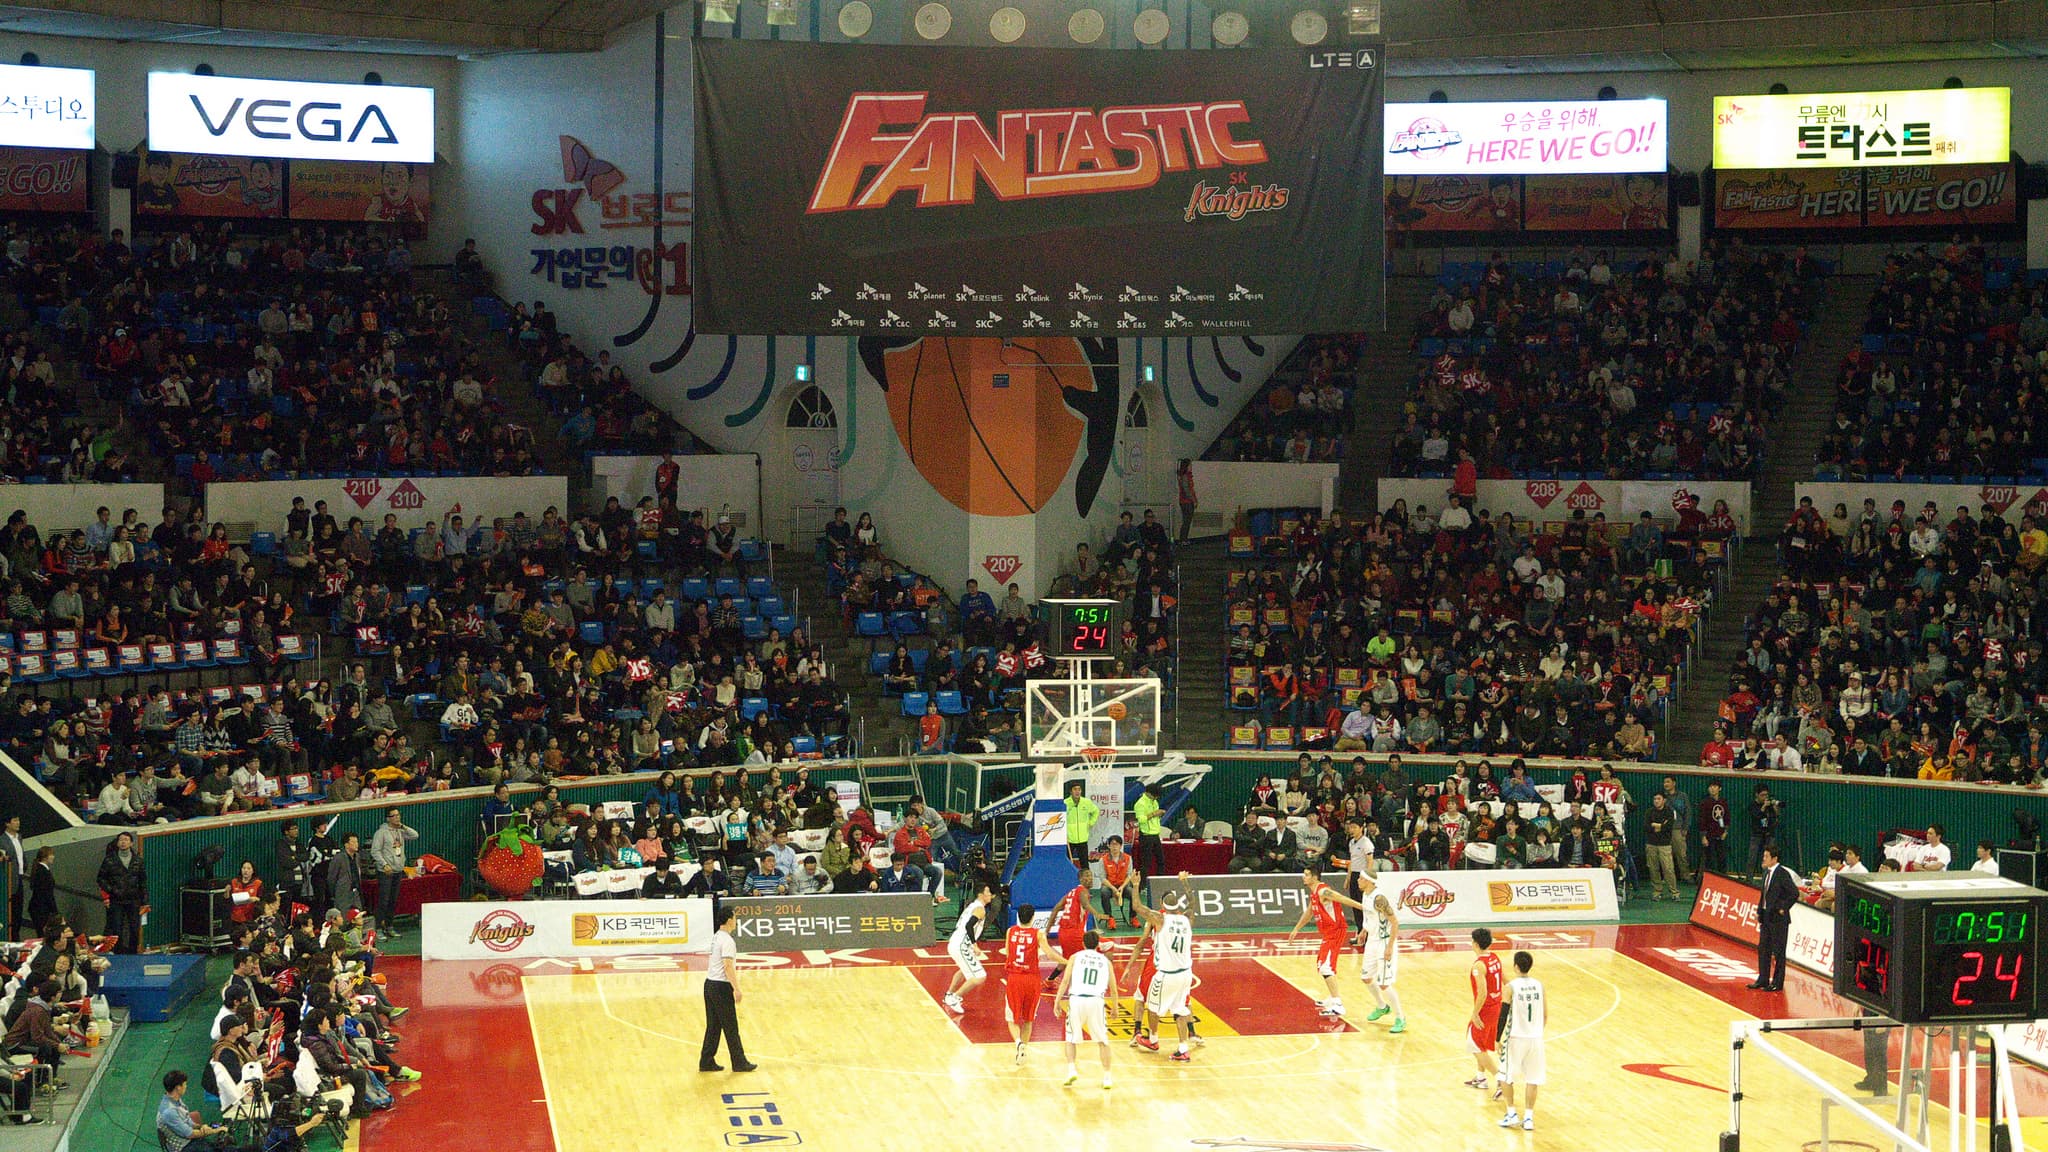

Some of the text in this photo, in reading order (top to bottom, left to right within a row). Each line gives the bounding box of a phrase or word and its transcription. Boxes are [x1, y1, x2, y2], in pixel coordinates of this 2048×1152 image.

[1309, 53, 1352, 69] LTE
[189, 94, 399, 144] VEGA
[1500, 108, 1554, 132] 우승을
[1718, 114, 1734, 125] SK
[1798, 103, 1846, 123] 무릎엔
[1466, 137, 1534, 165] HERE
[1538, 136, 1587, 163] WE
[1590, 121, 1656, 157] GO!!
[1796, 122, 1932, 161] 트라스트
[805, 91, 1267, 214] FANTASTIC
[1229, 171, 1248, 185] SK
[1183, 180, 1290, 222] Knights
[1800, 172, 2006, 218] HERE WE GO!!
[530, 189, 585, 235] SK
[810, 291, 823, 300] SK
[856, 291, 868, 300] SK
[907, 291, 946, 301] SK planet
[955, 293, 967, 302] SK
[1015, 293, 1027, 302] SK
[1068, 291, 1103, 302] SK hynix
[1118, 293, 1130, 302] SK
[1169, 293, 1181, 302] SK
[1228, 292, 1240, 301] SK
[831, 318, 843, 327] SK
[879, 318, 891, 327] SK
[927, 319, 940, 328] SK
[975, 319, 994, 328] SKC
[1022, 319, 1034, 328] SK
[1070, 319, 1082, 328] SK
[1116, 319, 1128, 329] SK
[1164, 319, 1176, 328] SK
[1201, 320, 1250, 328] WALKERHILL
[1463, 372, 1480, 388] SK
[351, 480, 376, 497] 210
[1530, 482, 1557, 497] 208
[1986, 487, 2014, 503] 207
[395, 492, 420, 508] 310
[1571, 494, 1598, 509] 308
[990, 557, 1016, 573] 209
[1075, 608, 1108, 623] 7:51
[1073, 625, 1107, 650] 24
[1090, 793, 1120, 806] 이벤트
[1594, 785, 1616, 804] SK
[1100, 808, 1120, 820] 기석
[1303, 834, 1321, 842] Jeep
[1516, 884, 1587, 898] KB 국민카드
[1397, 888, 1455, 911] Knights
[1700, 888, 1729, 919] 우체국
[734, 905, 763, 916] 2013
[775, 904, 803, 915] 2014
[603, 915, 681, 931] KB 국민카드
[737, 915, 922, 938] KB 국민카드 프로농구
[1858, 899, 1892, 938] 7:51
[469, 920, 535, 945] Knights
[1956, 911, 2027, 943] 7:51
[1171, 936, 1184, 954] 41
[1793, 932, 1819, 959] 우체국
[1015, 944, 1026, 963] 5
[523, 955, 684, 971] 서울
[1855, 937, 1890, 994] 24
[1083, 967, 1098, 986] 10
[1952, 951, 2023, 1007] 24
[1527, 1003, 1532, 1022] 1
